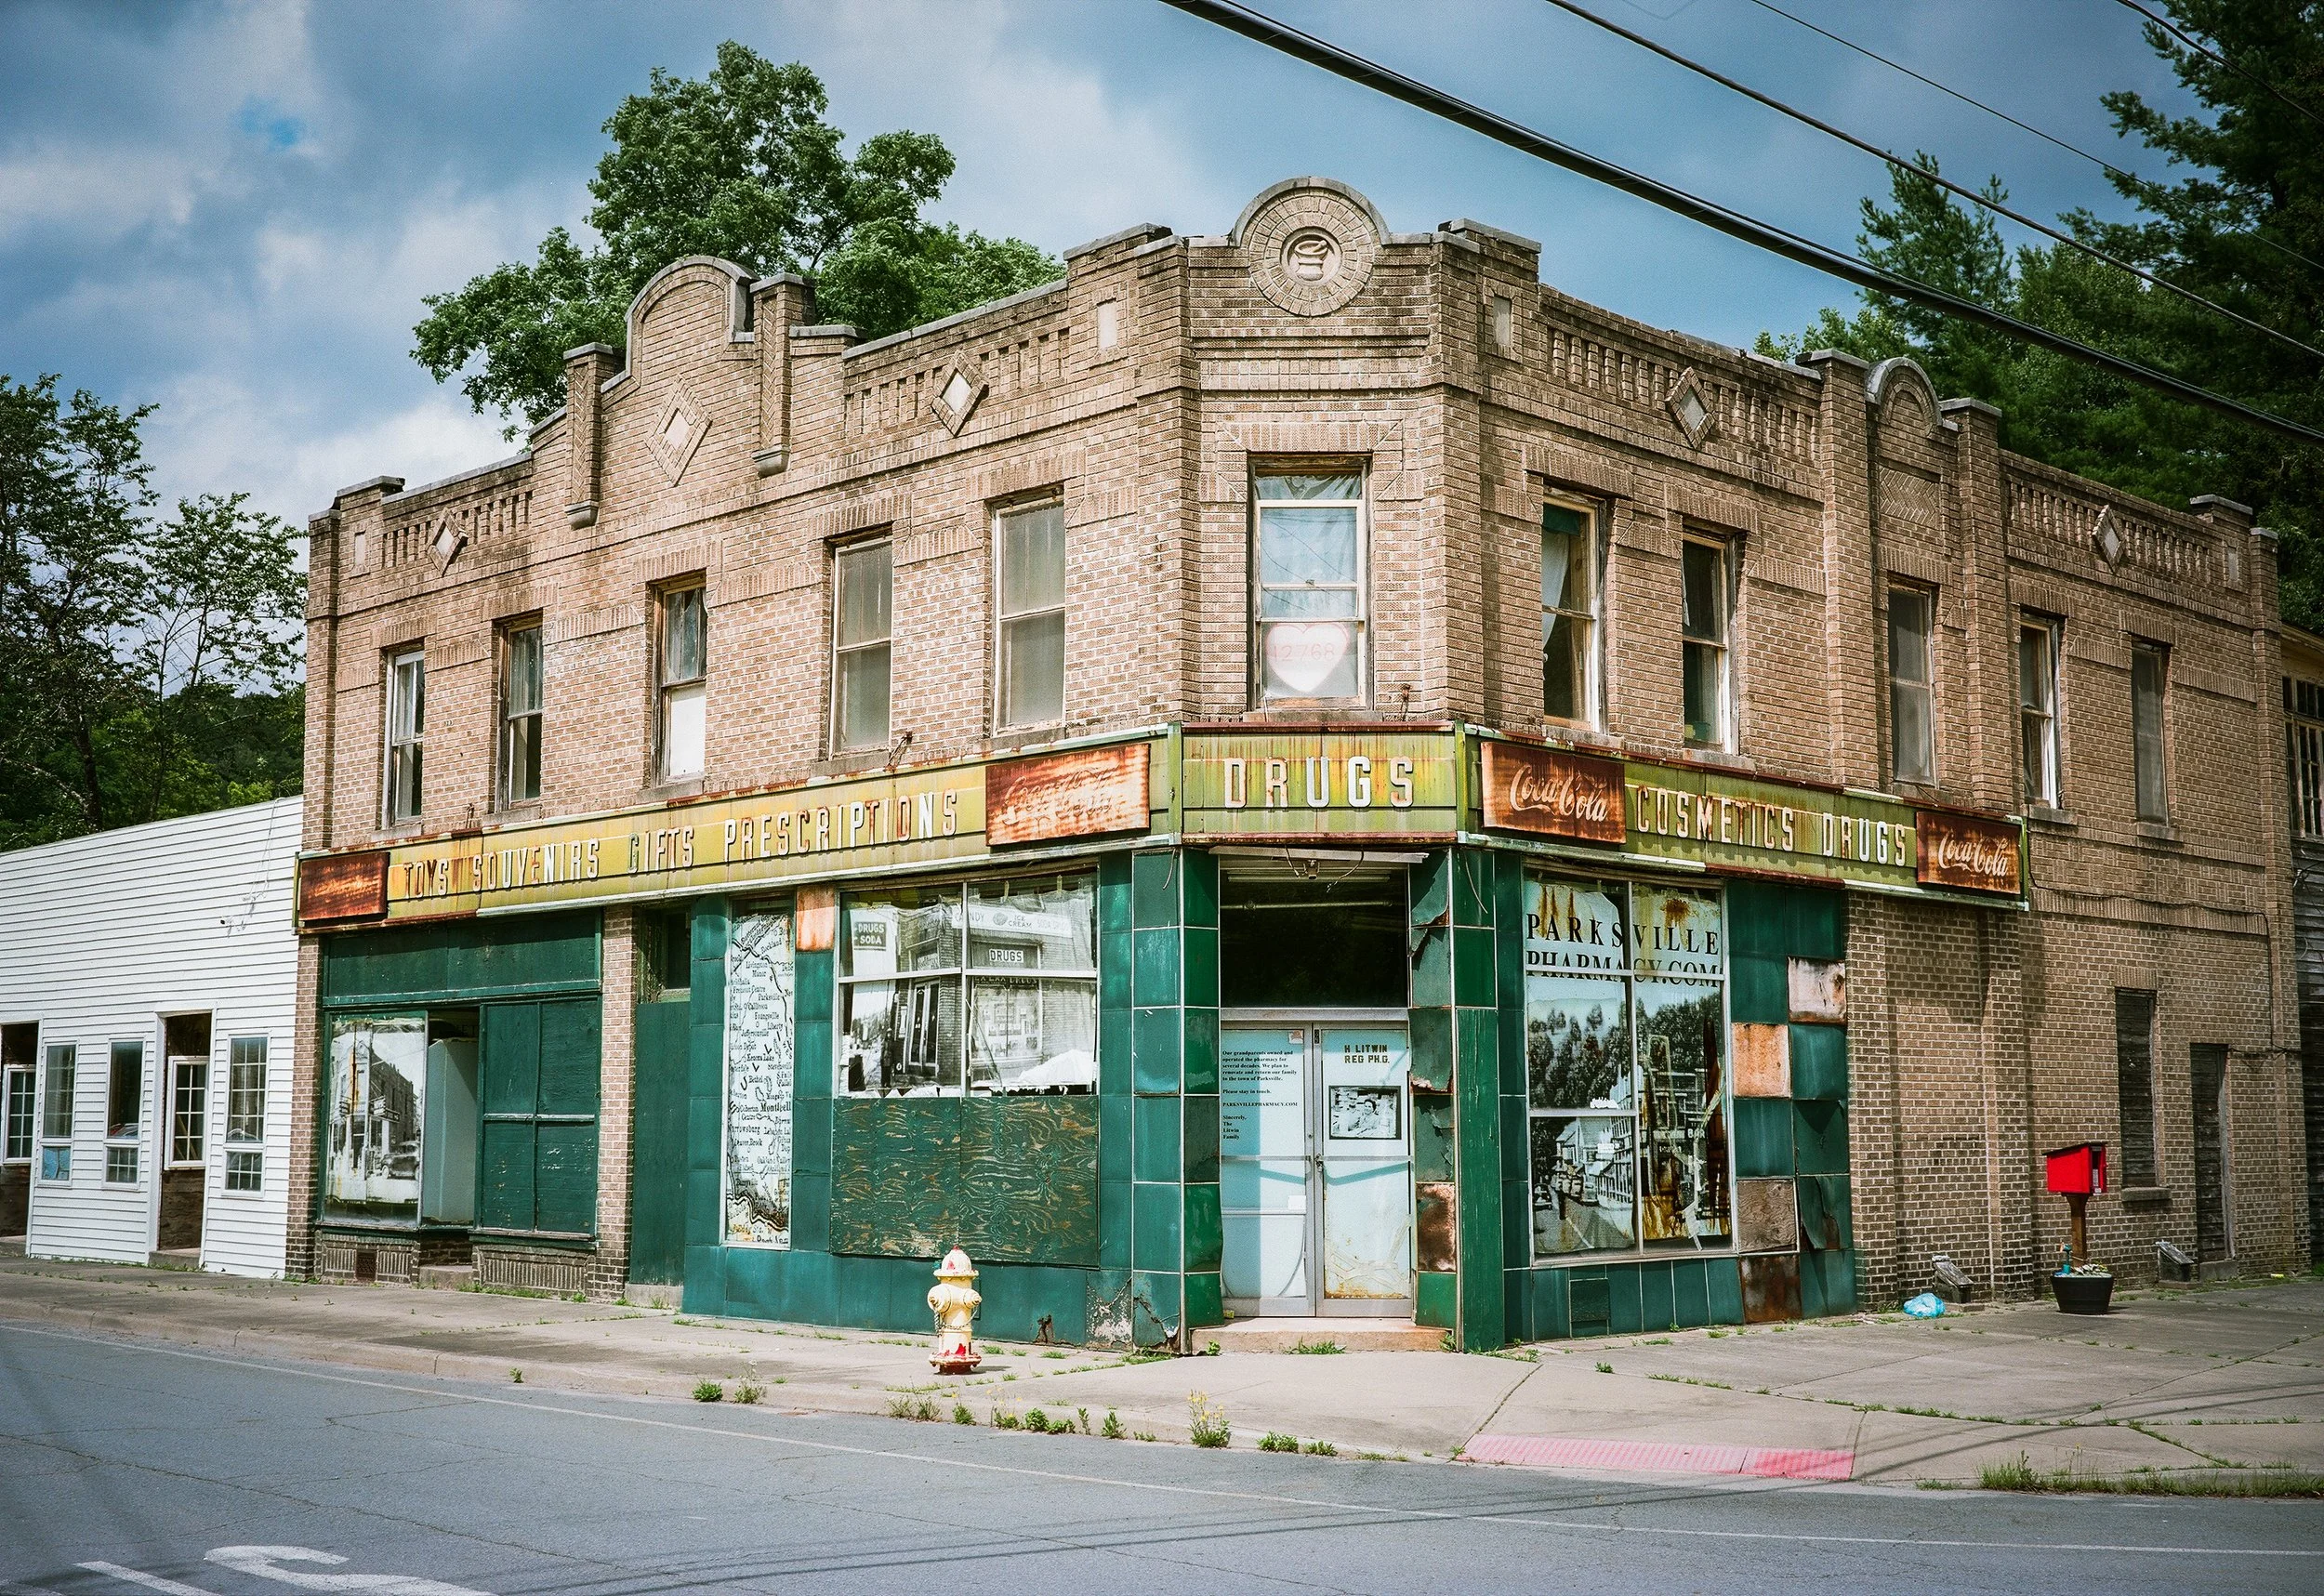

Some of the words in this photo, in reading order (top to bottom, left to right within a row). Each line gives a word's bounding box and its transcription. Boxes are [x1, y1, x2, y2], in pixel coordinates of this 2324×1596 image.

[1224, 756, 1413, 808] DRUGS
[1510, 764, 1608, 822] Coca-Cola
[403, 858, 448, 899] TOYS
[472, 838, 600, 891] SOUVENIRS
[627, 824, 694, 874] GIFTS
[724, 788, 957, 863] PRESCRIPTIONS
[1636, 785, 1794, 851] COSMETICS
[1822, 812, 1906, 867] DRUGS
[1938, 829, 2008, 877] Coca-Cola
[858, 922, 885, 933] DRUGS
[860, 935, 882, 944] SODA
[1526, 913, 1719, 956] PARKSVILLE
[990, 950, 1023, 962] DRUGS
[1344, 1045, 1351, 1053] H
[1355, 1045, 1387, 1053] LITWIN
[1344, 1055, 1365, 1063] REG
